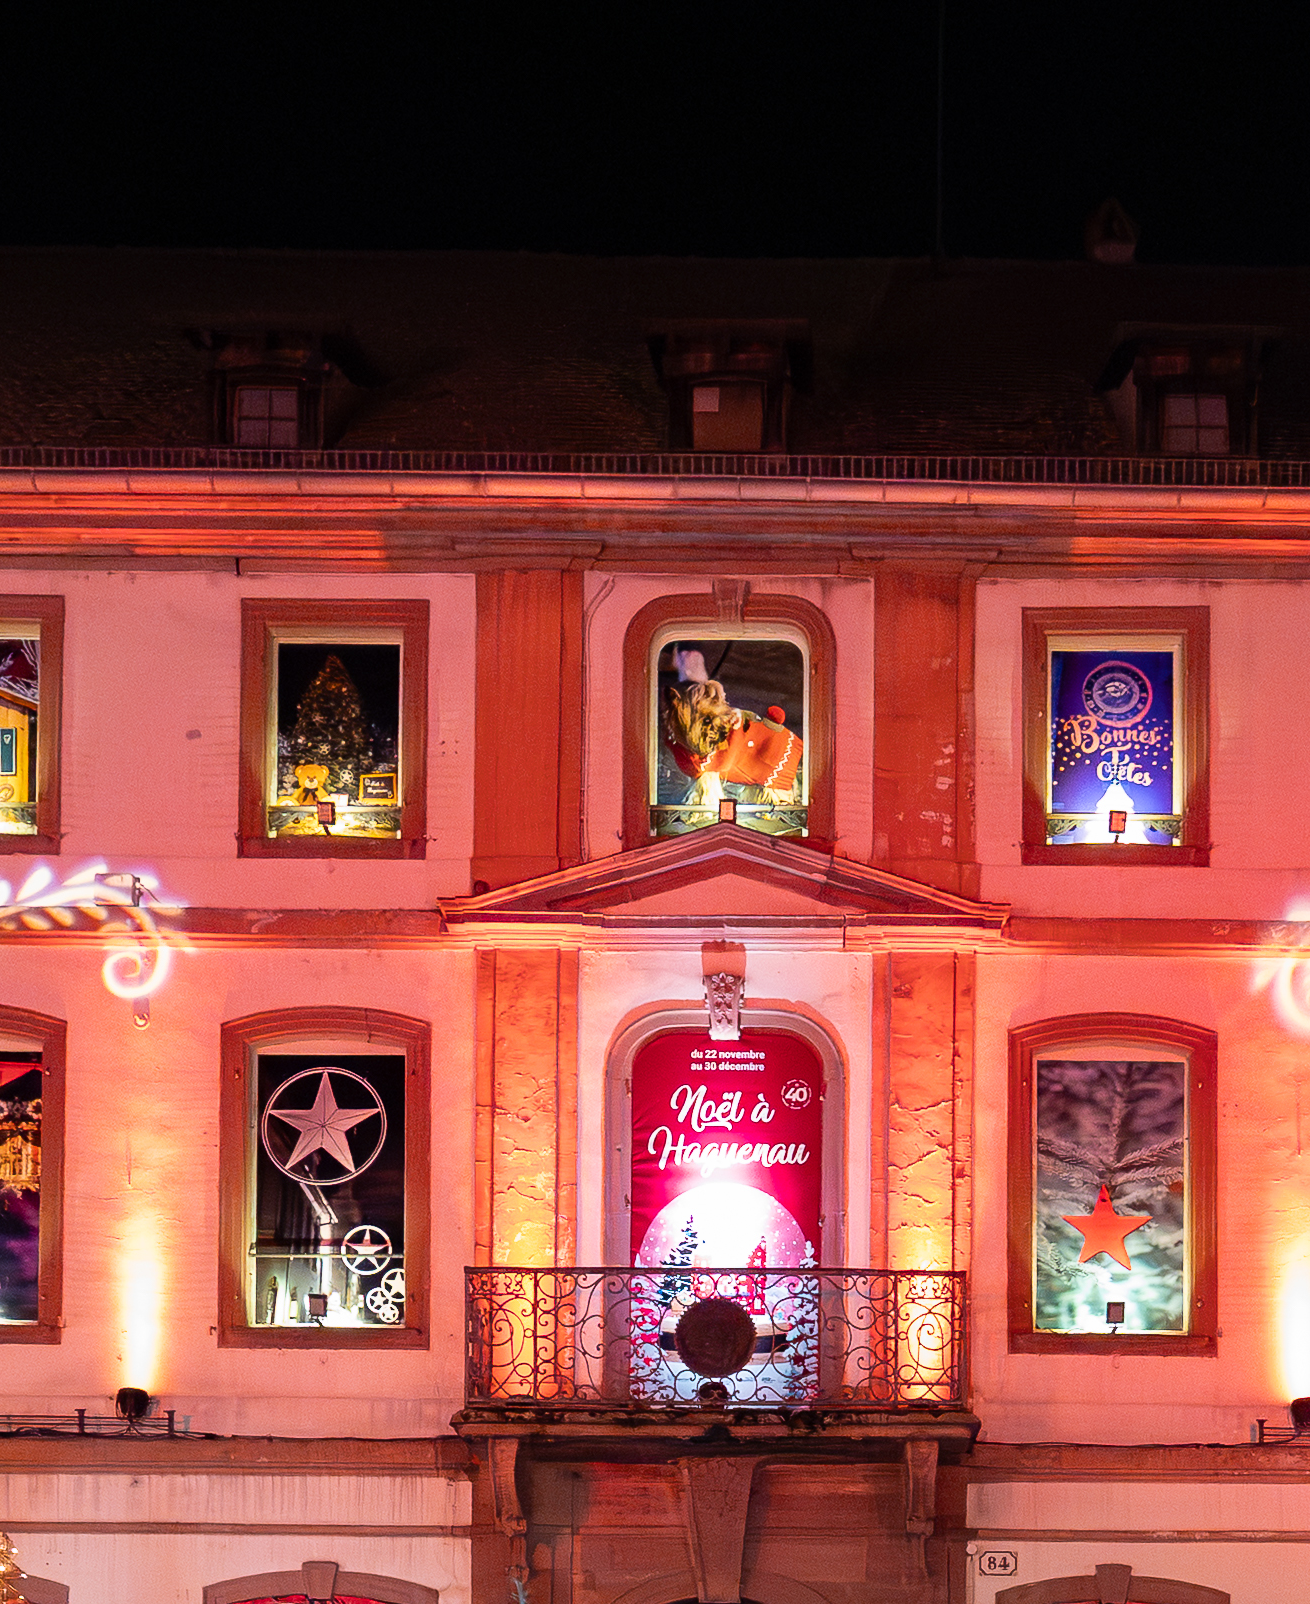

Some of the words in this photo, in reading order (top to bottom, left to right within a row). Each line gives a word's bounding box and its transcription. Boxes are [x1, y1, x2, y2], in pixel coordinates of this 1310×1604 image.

[1063, 716, 1159, 754] Bonnes
[690, 1049, 704, 1059] du
[705, 1050, 717, 1059] 22
[719, 1050, 766, 1060] novembre
[690, 1063, 703, 1071] au
[704, 1062, 717, 1071] 30
[718, 1061, 765, 1071] décembre
[784, 1086, 809, 1103] 40
[670, 1084, 745, 1133] Noël
[750, 1093, 776, 1124] à
[647, 1125, 811, 1179] Haguenau
[986, 1556, 1011, 1571] 84
